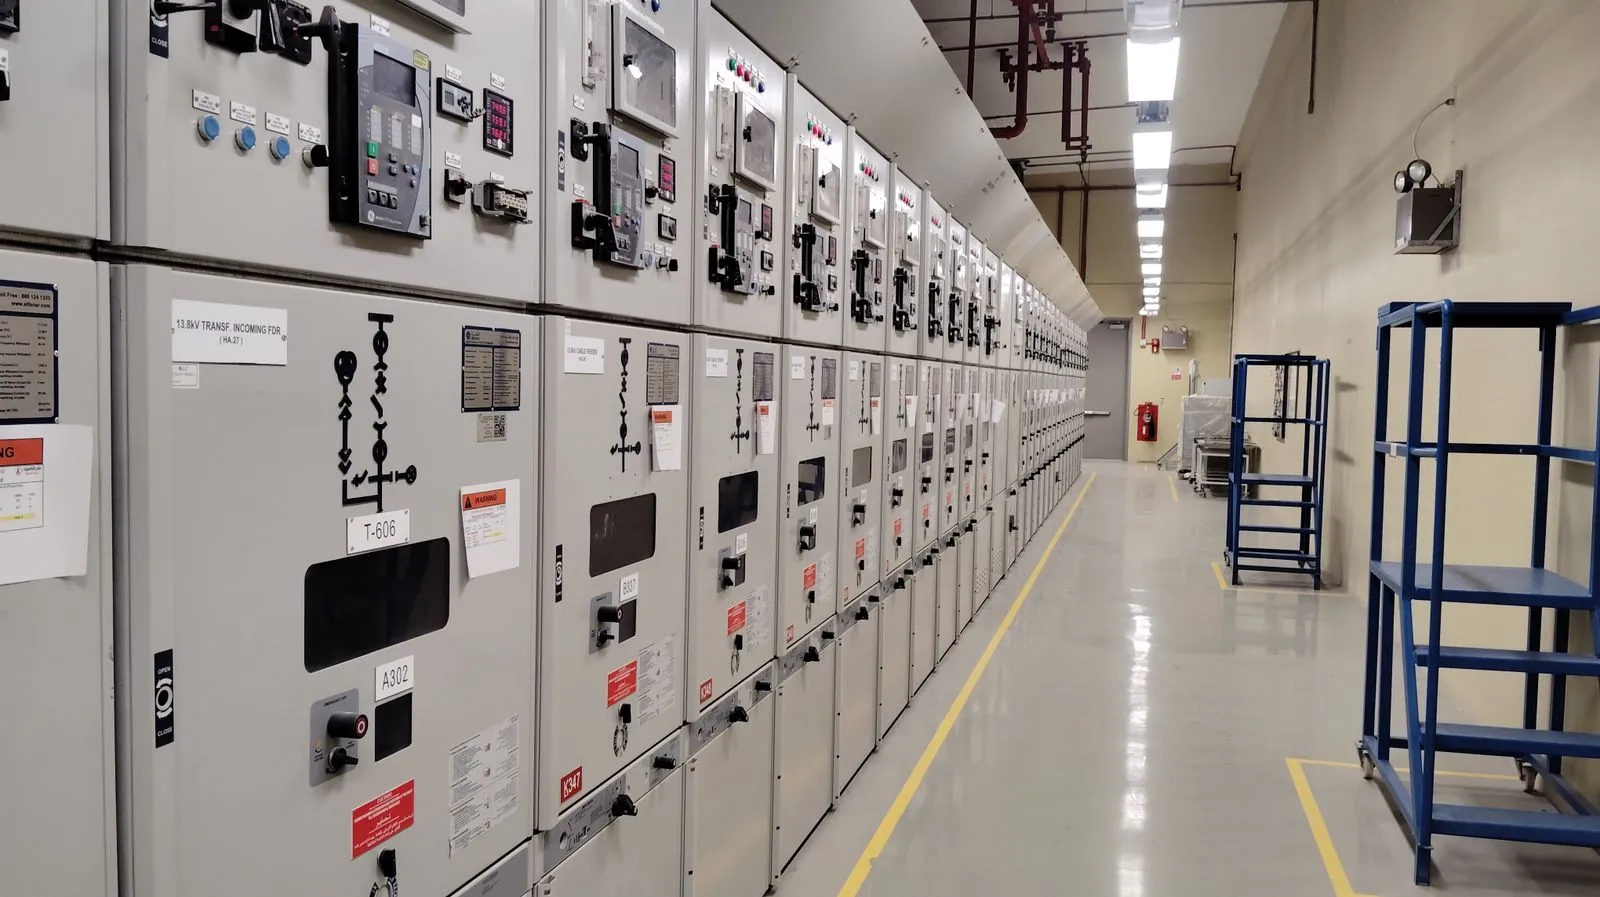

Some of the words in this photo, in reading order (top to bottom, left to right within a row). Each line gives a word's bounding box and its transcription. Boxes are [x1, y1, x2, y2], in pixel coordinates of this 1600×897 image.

[151, 37, 168, 48] CLOSE
[176, 319, 200, 330] 13.8kV
[201, 320, 232, 332] TRANSF.
[233, 323, 267, 335] INCOMING
[267, 325, 281, 336] FDR
[222, 335, 240, 345] HA.27
[474, 493, 498, 505] WARNING
[364, 519, 396, 541] T-606
[157, 666, 171, 675] OPEN
[381, 664, 409, 691] A302
[156, 726, 173, 737] CLOSE
[563, 771, 581, 799] K347
